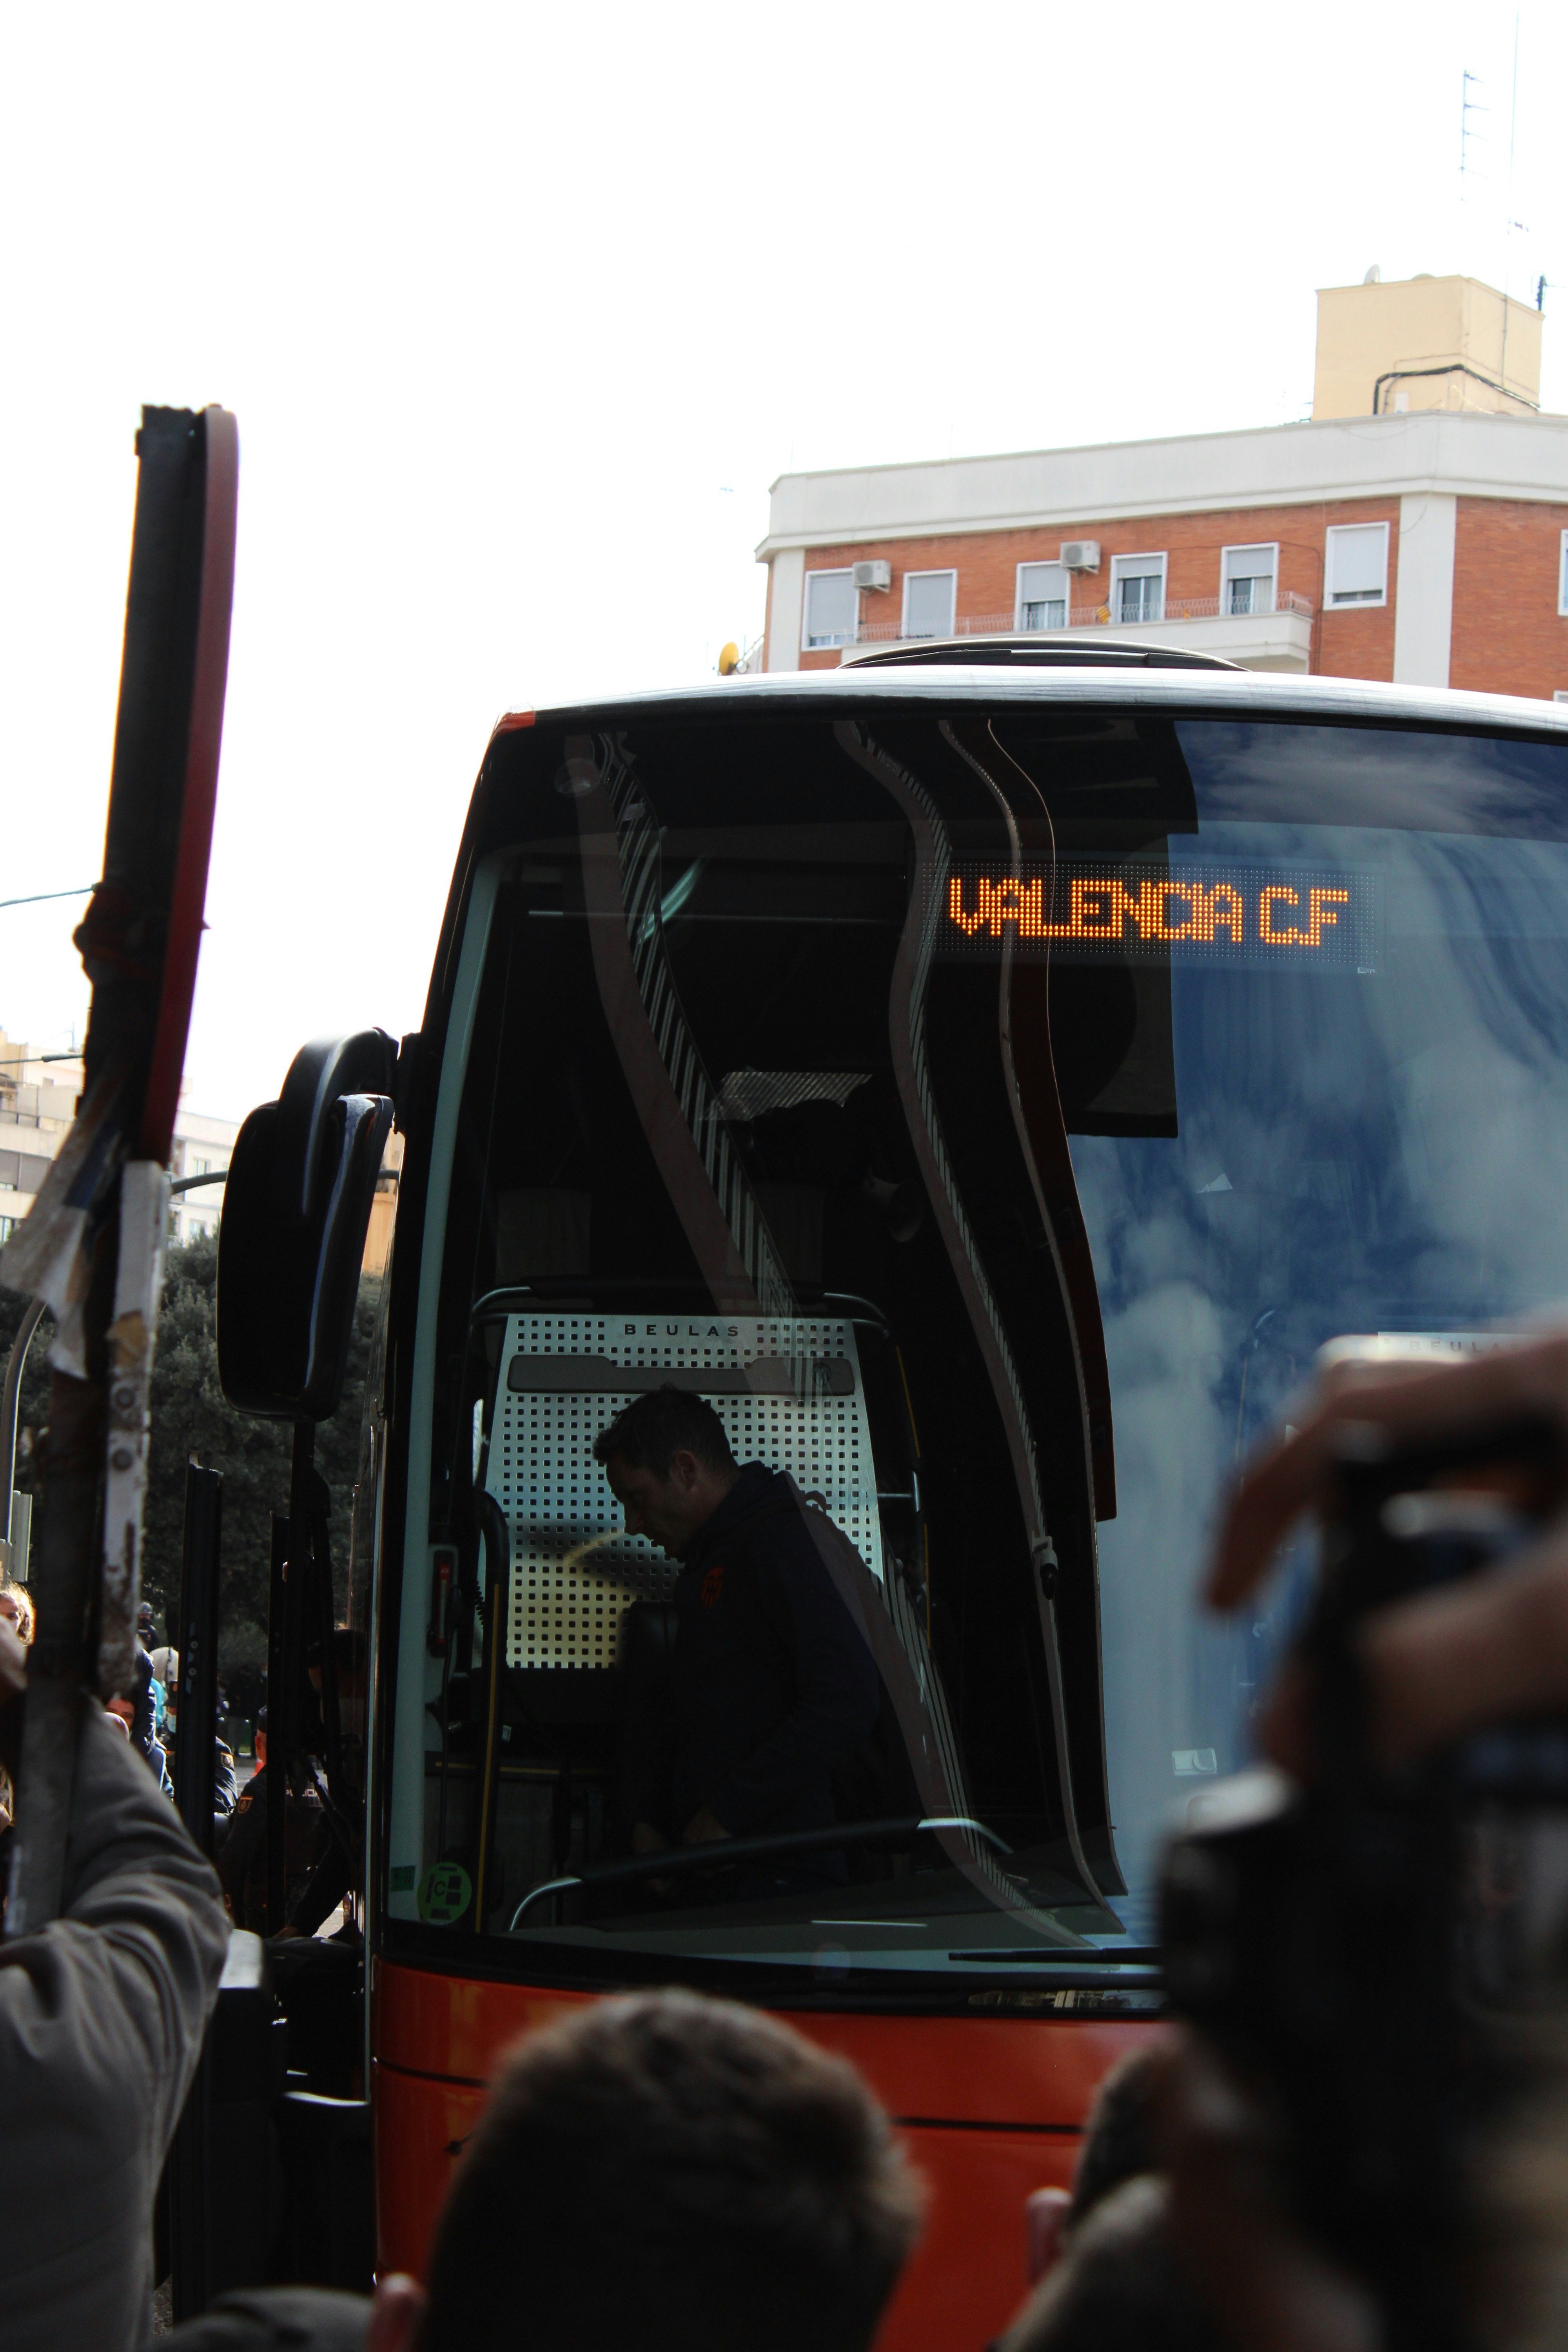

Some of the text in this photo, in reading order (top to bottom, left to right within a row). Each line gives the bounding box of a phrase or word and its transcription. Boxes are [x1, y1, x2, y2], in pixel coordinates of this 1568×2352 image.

[949, 878, 1243, 942] VALENCIA
[624, 1324, 739, 1337] BEULAS
[434, 1881, 446, 1896] C
